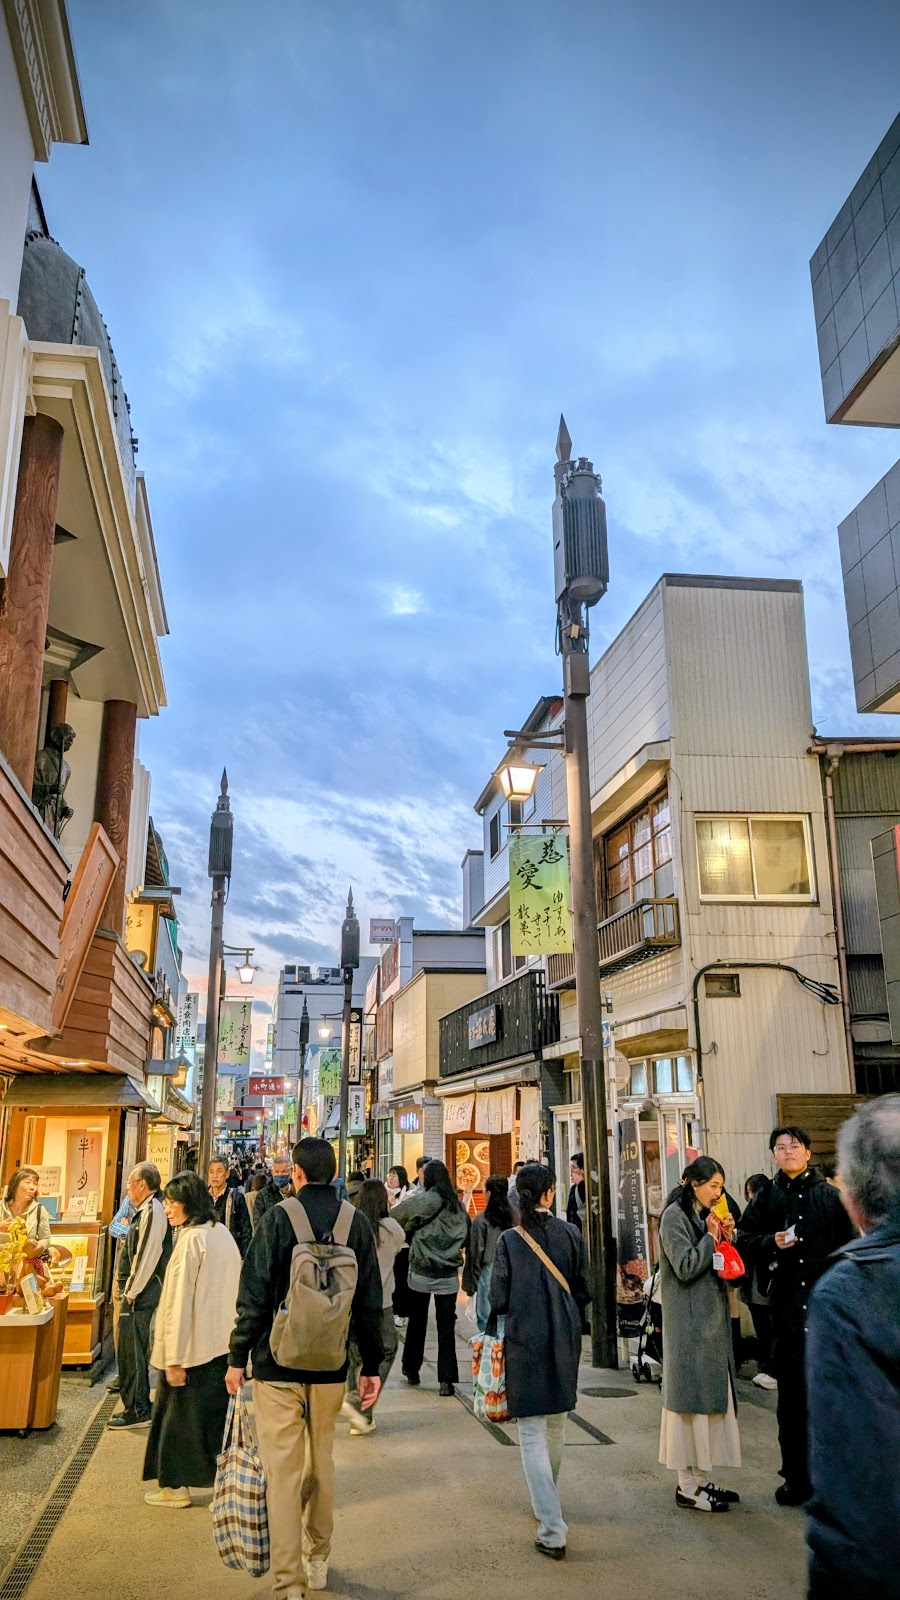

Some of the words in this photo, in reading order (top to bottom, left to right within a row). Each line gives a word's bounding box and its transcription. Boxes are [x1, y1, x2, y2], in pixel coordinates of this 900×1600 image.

[514, 904, 532, 947] 散策へ
[530, 912, 542, 947] 守って
[542, 906, 552, 938] マナー
[183, 994, 192, 1036] 東洋食肉店
[235, 1004, 249, 1056] 千客万来
[253, 1083, 281, 1091] 小町通り
